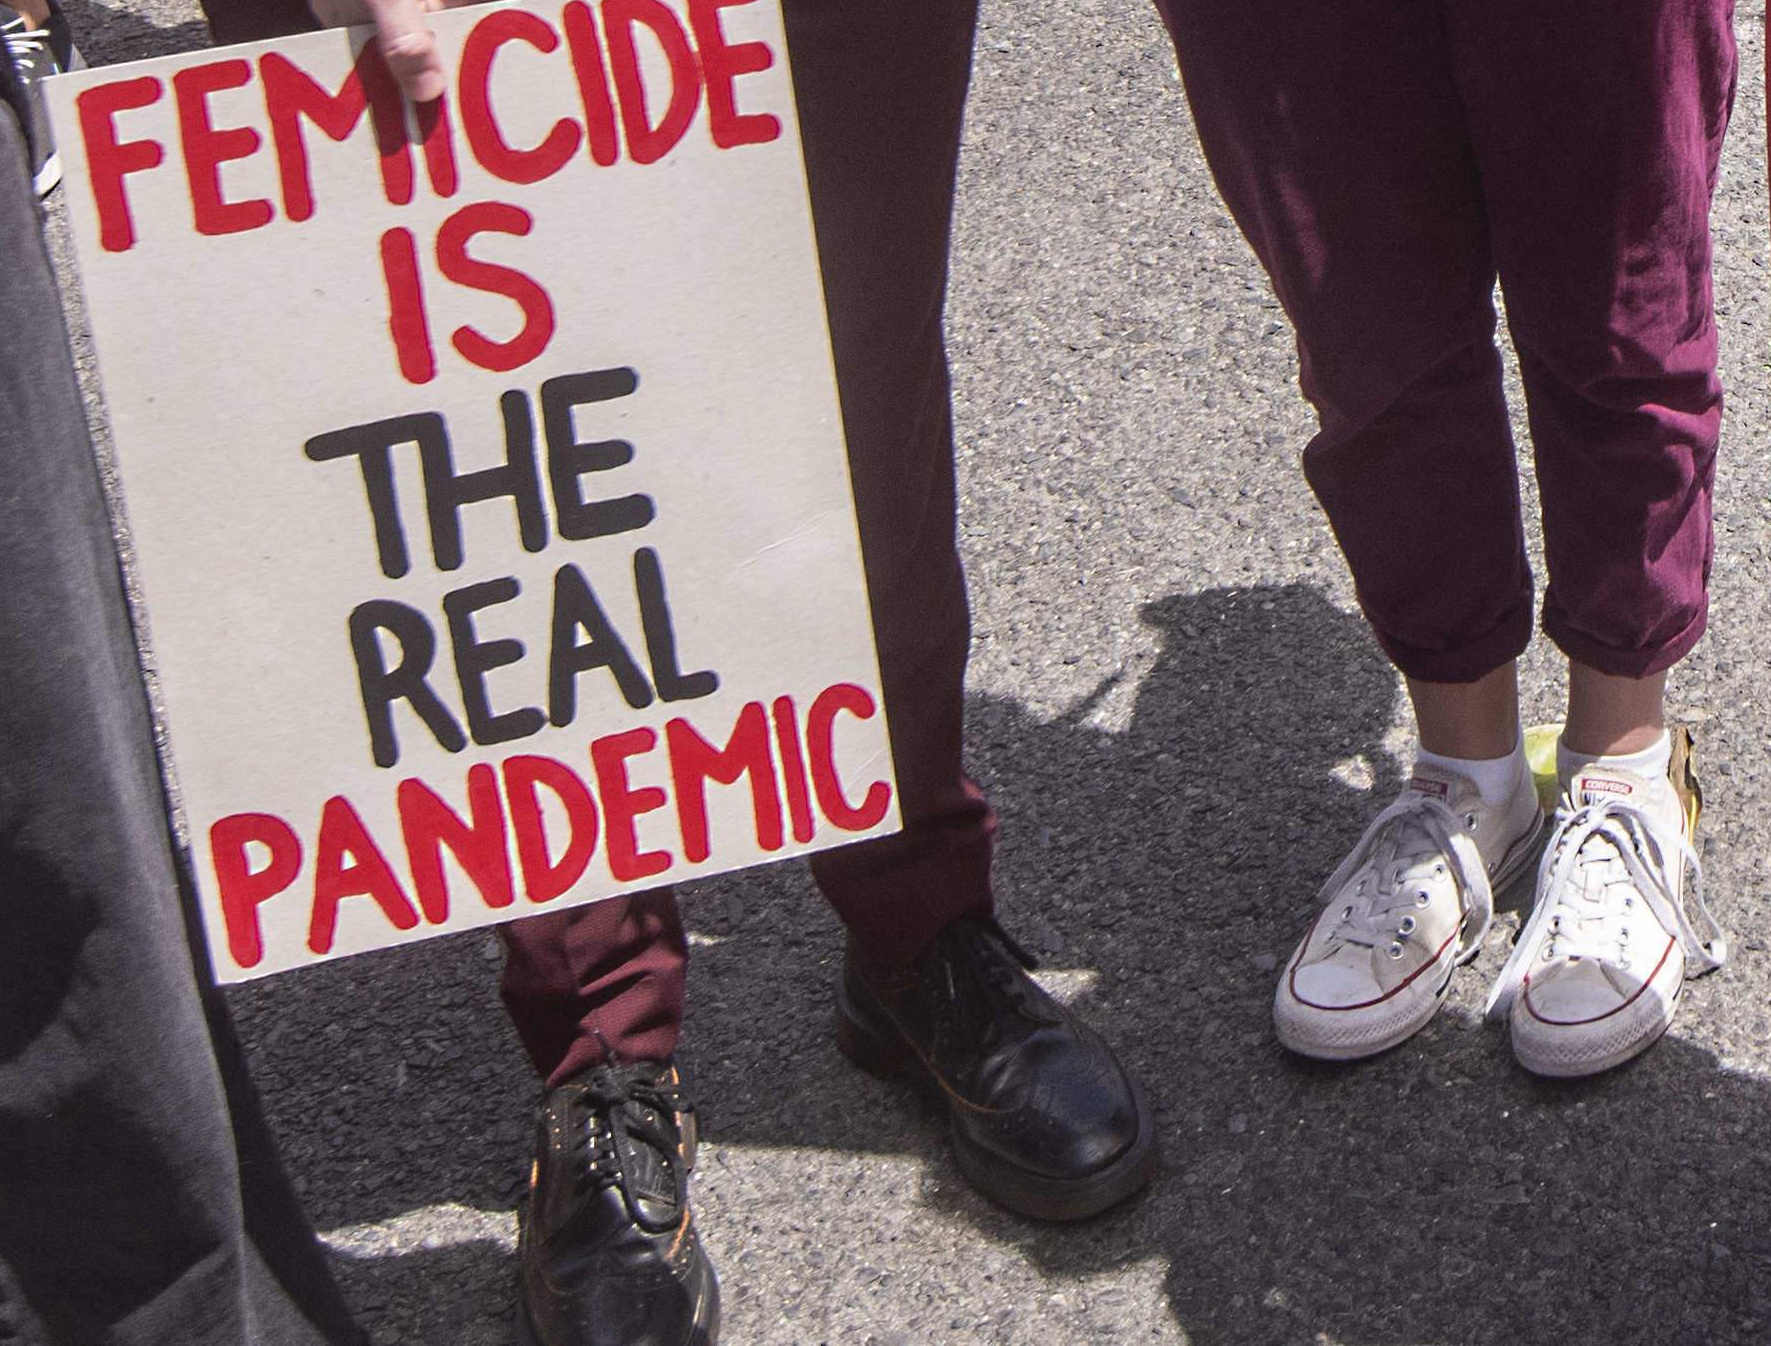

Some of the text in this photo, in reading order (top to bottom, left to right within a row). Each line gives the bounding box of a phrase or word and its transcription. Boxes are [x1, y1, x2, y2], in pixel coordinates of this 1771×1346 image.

[379, 200, 557, 385] IS
[303, 364, 659, 581] THE
[347, 545, 720, 770] REAL
[207, 680, 893, 969] PANDEMIC
